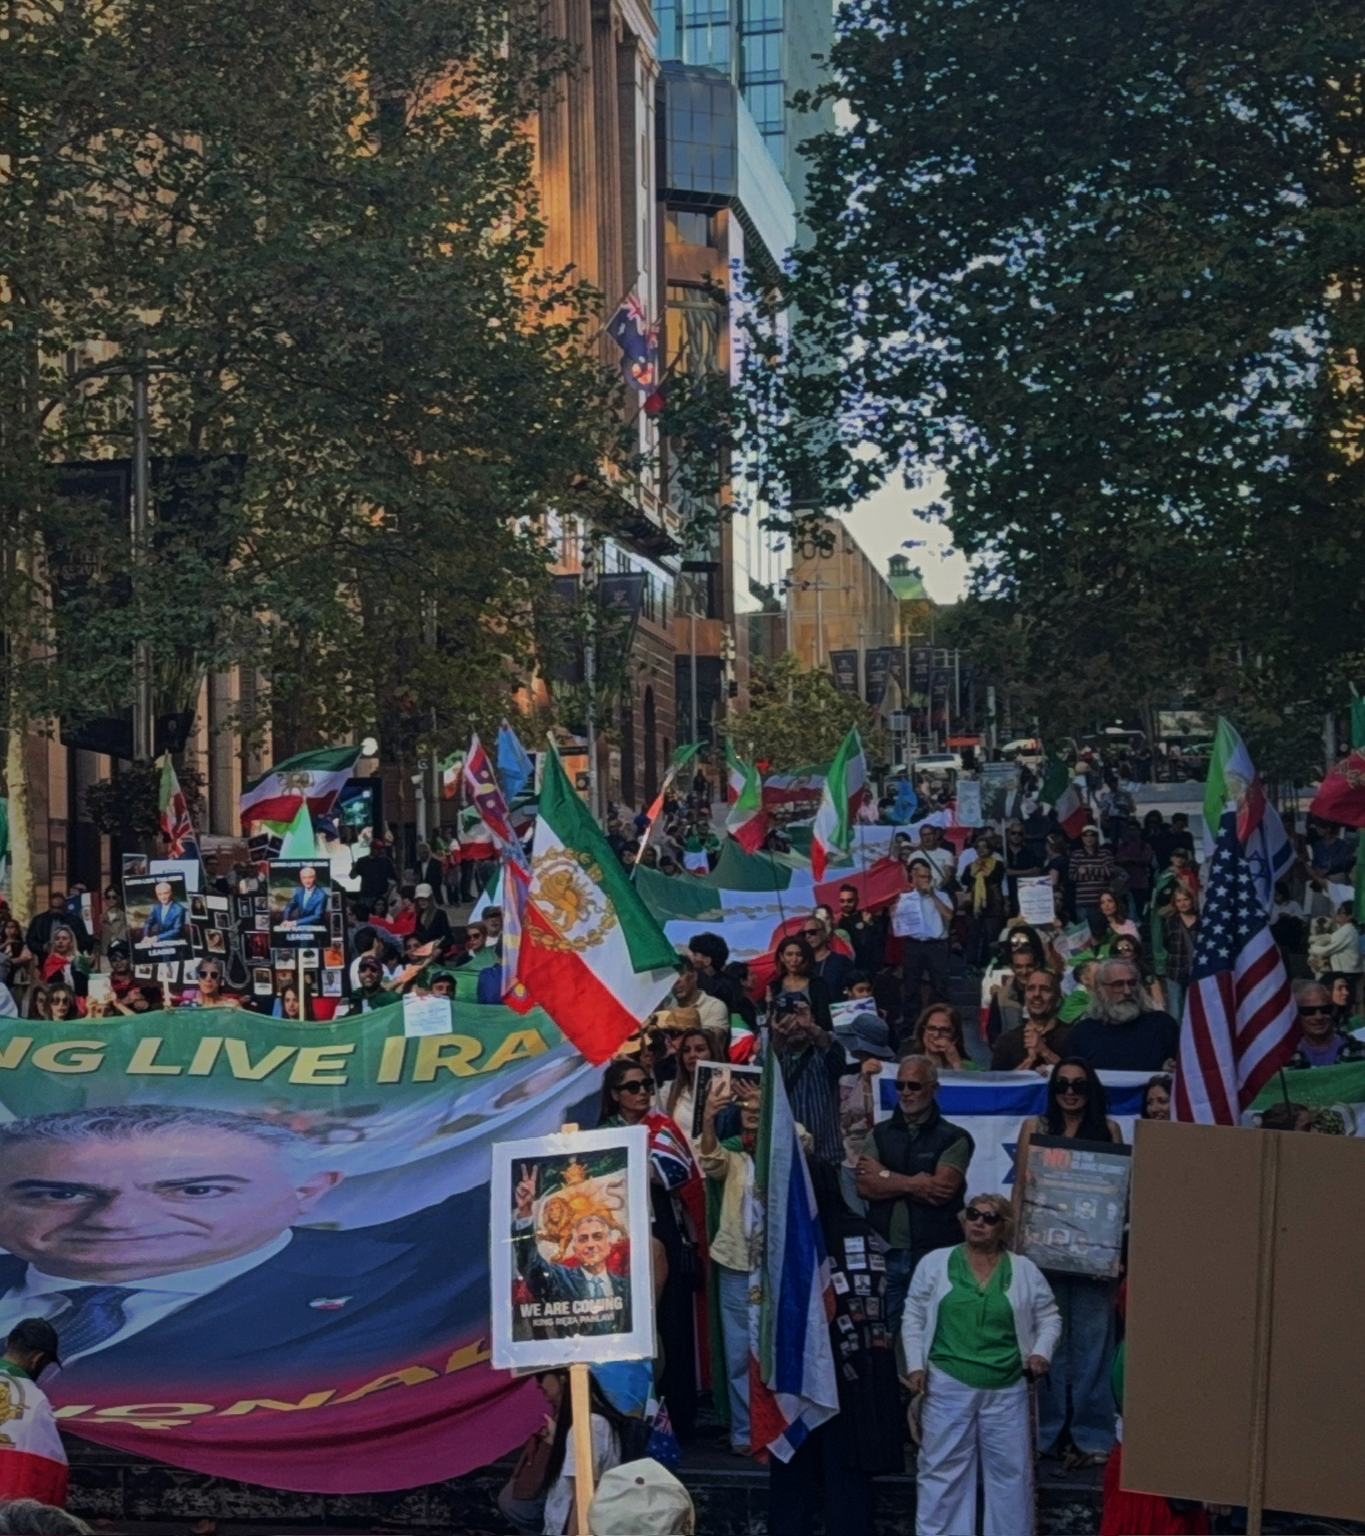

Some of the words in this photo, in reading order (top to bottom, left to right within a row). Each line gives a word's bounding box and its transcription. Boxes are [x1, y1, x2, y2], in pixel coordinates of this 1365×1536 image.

[126, 1035, 355, 1085] LIVE
[376, 1028, 550, 1085] IRA
[520, 1303, 542, 1318] WE
[544, 1301, 570, 1316] ARE
